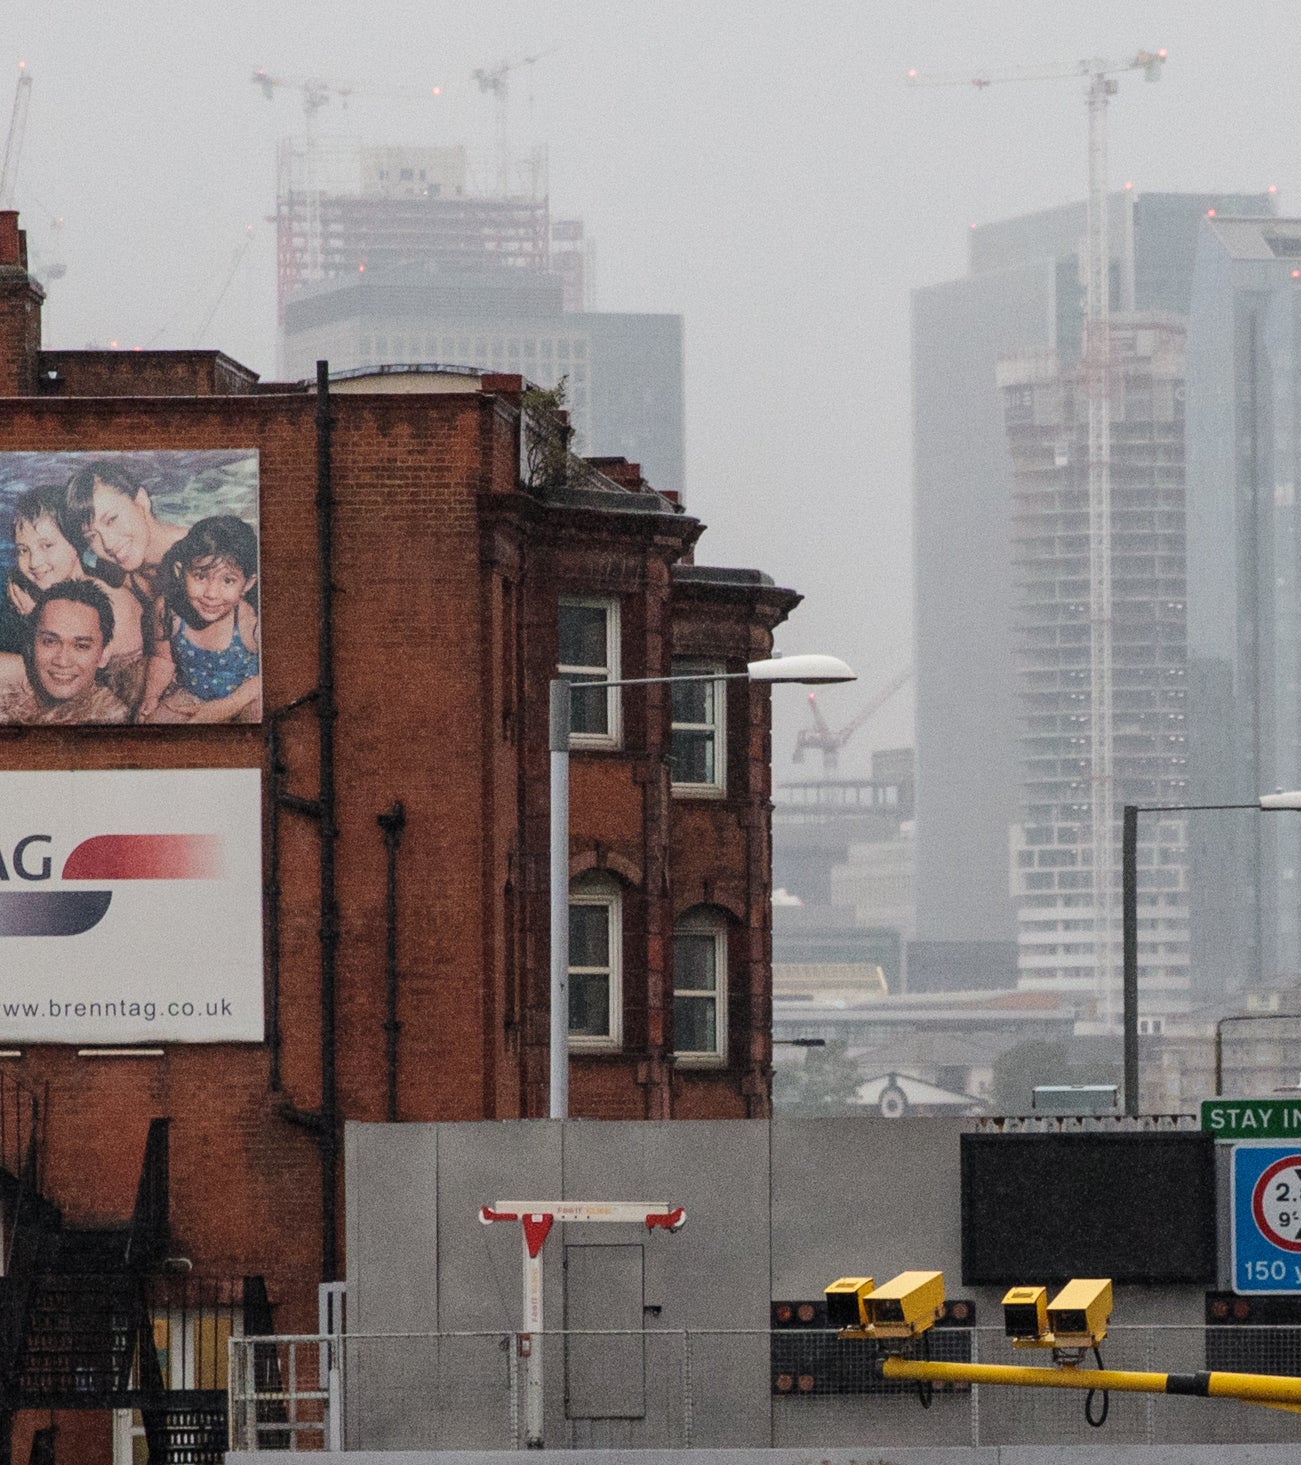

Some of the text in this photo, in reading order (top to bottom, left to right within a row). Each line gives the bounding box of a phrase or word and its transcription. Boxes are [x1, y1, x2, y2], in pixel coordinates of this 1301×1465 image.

[0, 835, 53, 881] G
[1210, 1108, 1272, 1128] STAY
[1245, 1260, 1286, 1281] 150
